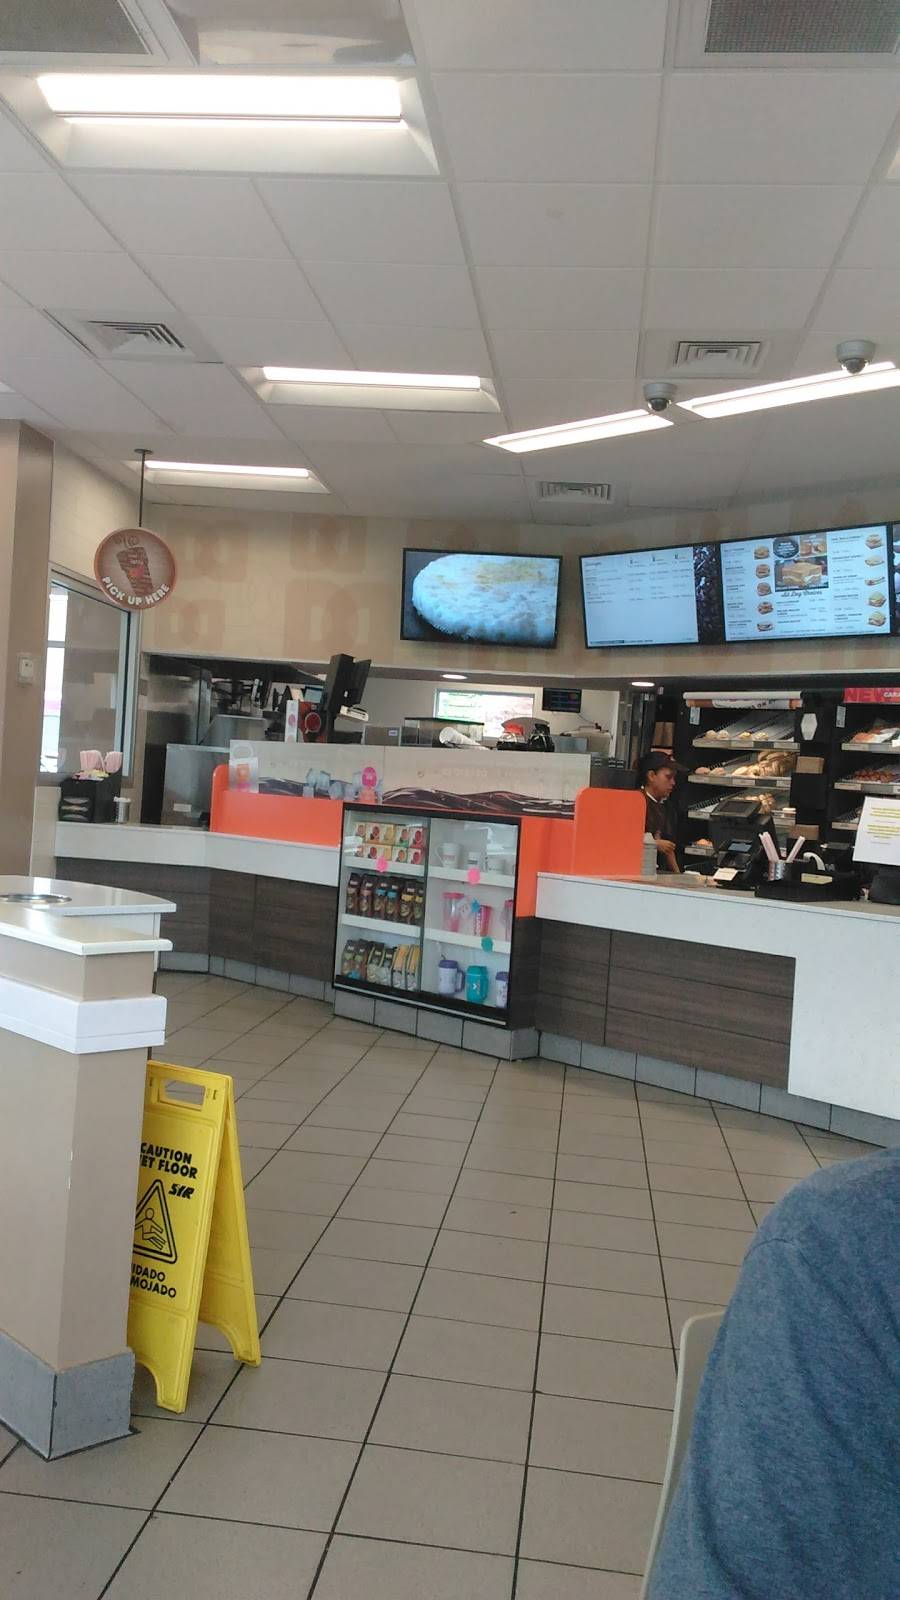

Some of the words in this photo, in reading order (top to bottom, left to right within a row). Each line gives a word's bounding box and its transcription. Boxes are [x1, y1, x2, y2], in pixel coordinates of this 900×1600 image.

[102, 576, 126, 600] PICK
[127, 595, 142, 606] UP
[145, 583, 170, 605] HERE
[140, 1142, 192, 1165] CAUTION
[140, 1154, 155, 1169] ET
[158, 1159, 198, 1179] FLOOR
[131, 1263, 166, 1282] IDADO
[130, 1276, 177, 1298] MOJADO
